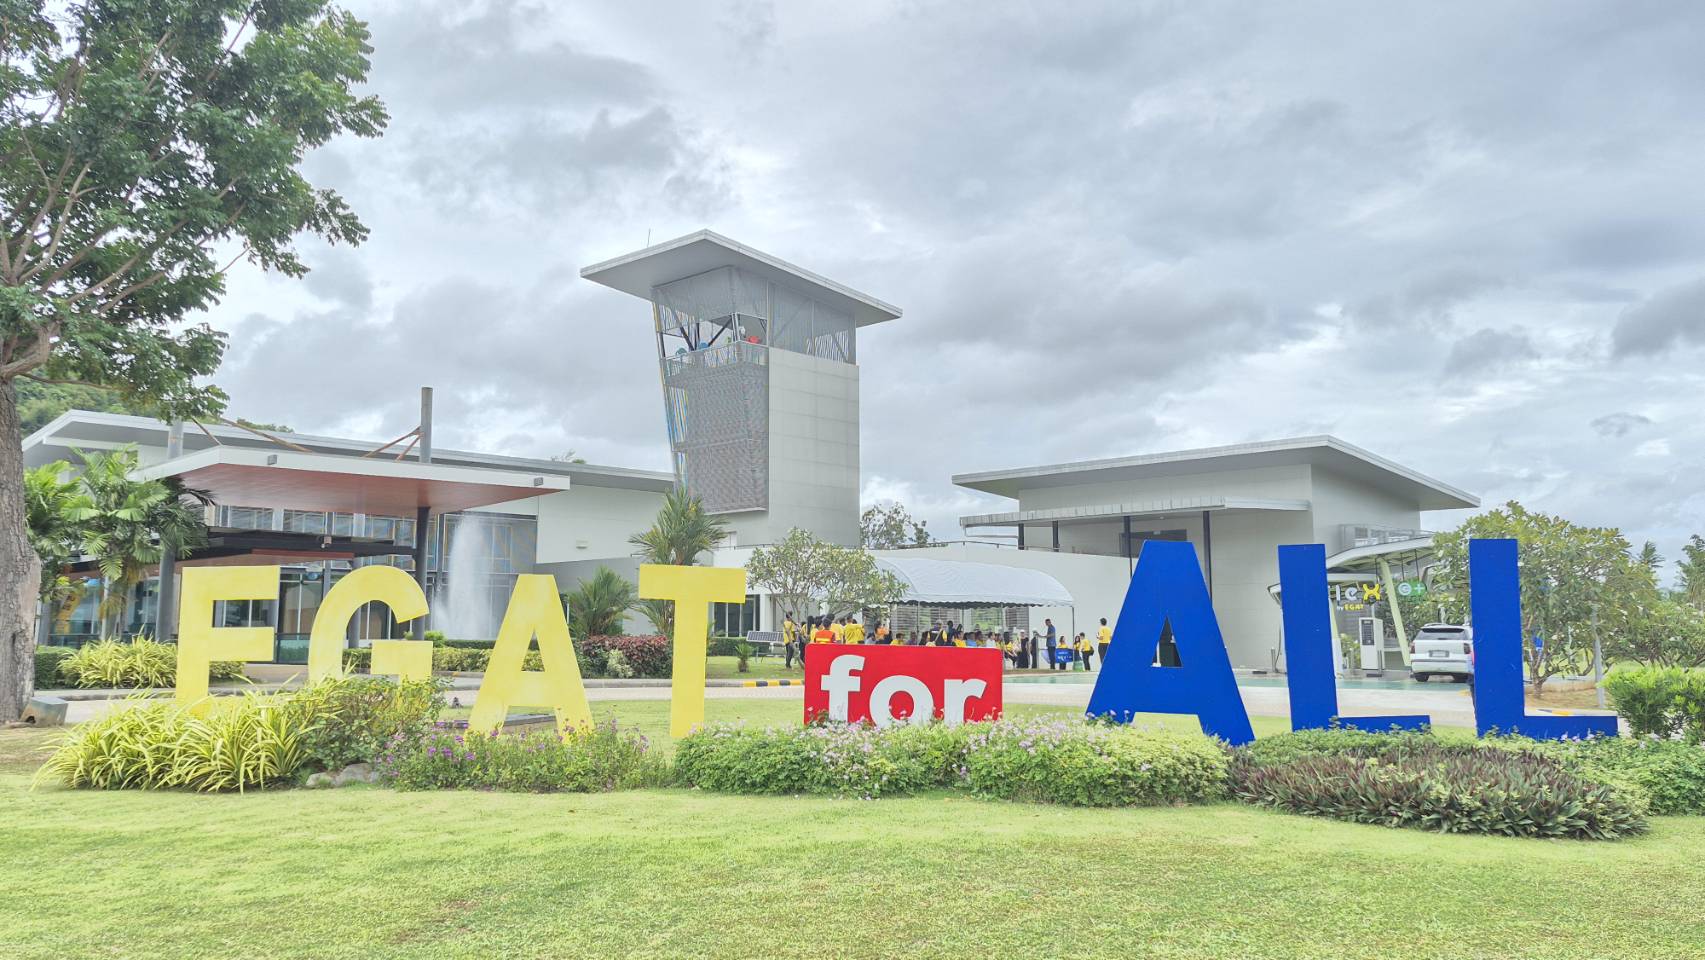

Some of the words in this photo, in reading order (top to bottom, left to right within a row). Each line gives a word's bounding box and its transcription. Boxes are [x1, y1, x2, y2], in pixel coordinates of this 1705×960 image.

[176, 564, 746, 737] EGAT
[821, 654, 987, 728] for
[1086, 539, 1617, 745] ALL
